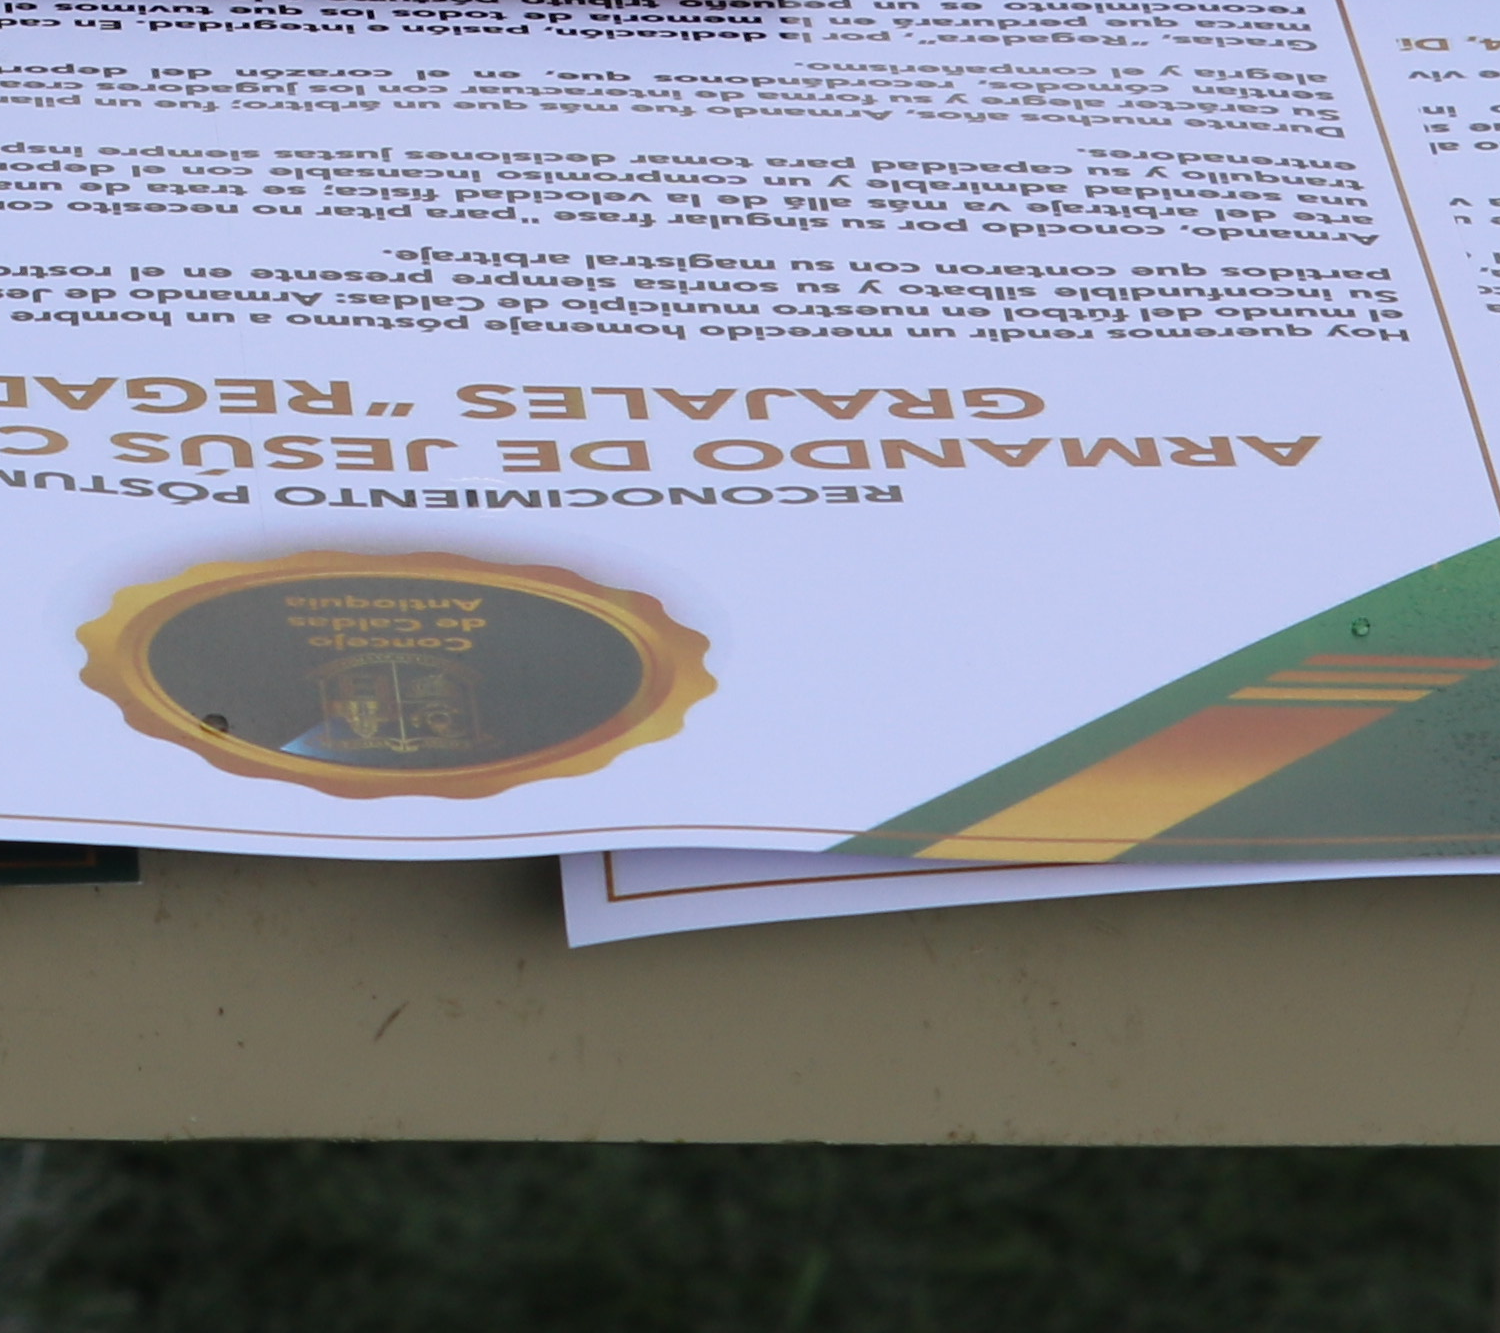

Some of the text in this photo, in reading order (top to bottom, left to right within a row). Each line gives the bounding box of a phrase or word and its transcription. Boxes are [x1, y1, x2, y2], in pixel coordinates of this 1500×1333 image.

[382, 246, 1392, 282] partidos que contaron con su magistral arbitraje.
[10, 310, 172, 327] hombre
[186, 312, 235, 323] un
[249, 313, 272, 324] a
[286, 314, 469, 333] póstumo
[484, 316, 686, 341] homenaje
[699, 325, 893, 341] merecido
[906, 327, 956, 338] un
[969, 328, 1094, 343] rendir
[1106, 323, 1313, 339] queremos
[1326, 324, 1410, 342] Hoy
[456, 384, 1045, 420] GRAJALES
[110, 432, 459, 472] JESÚS
[496, 440, 652, 473] DE
[693, 436, 1322, 471] ARMANDO
[274, 485, 904, 509] RECONOCIMIENTO
